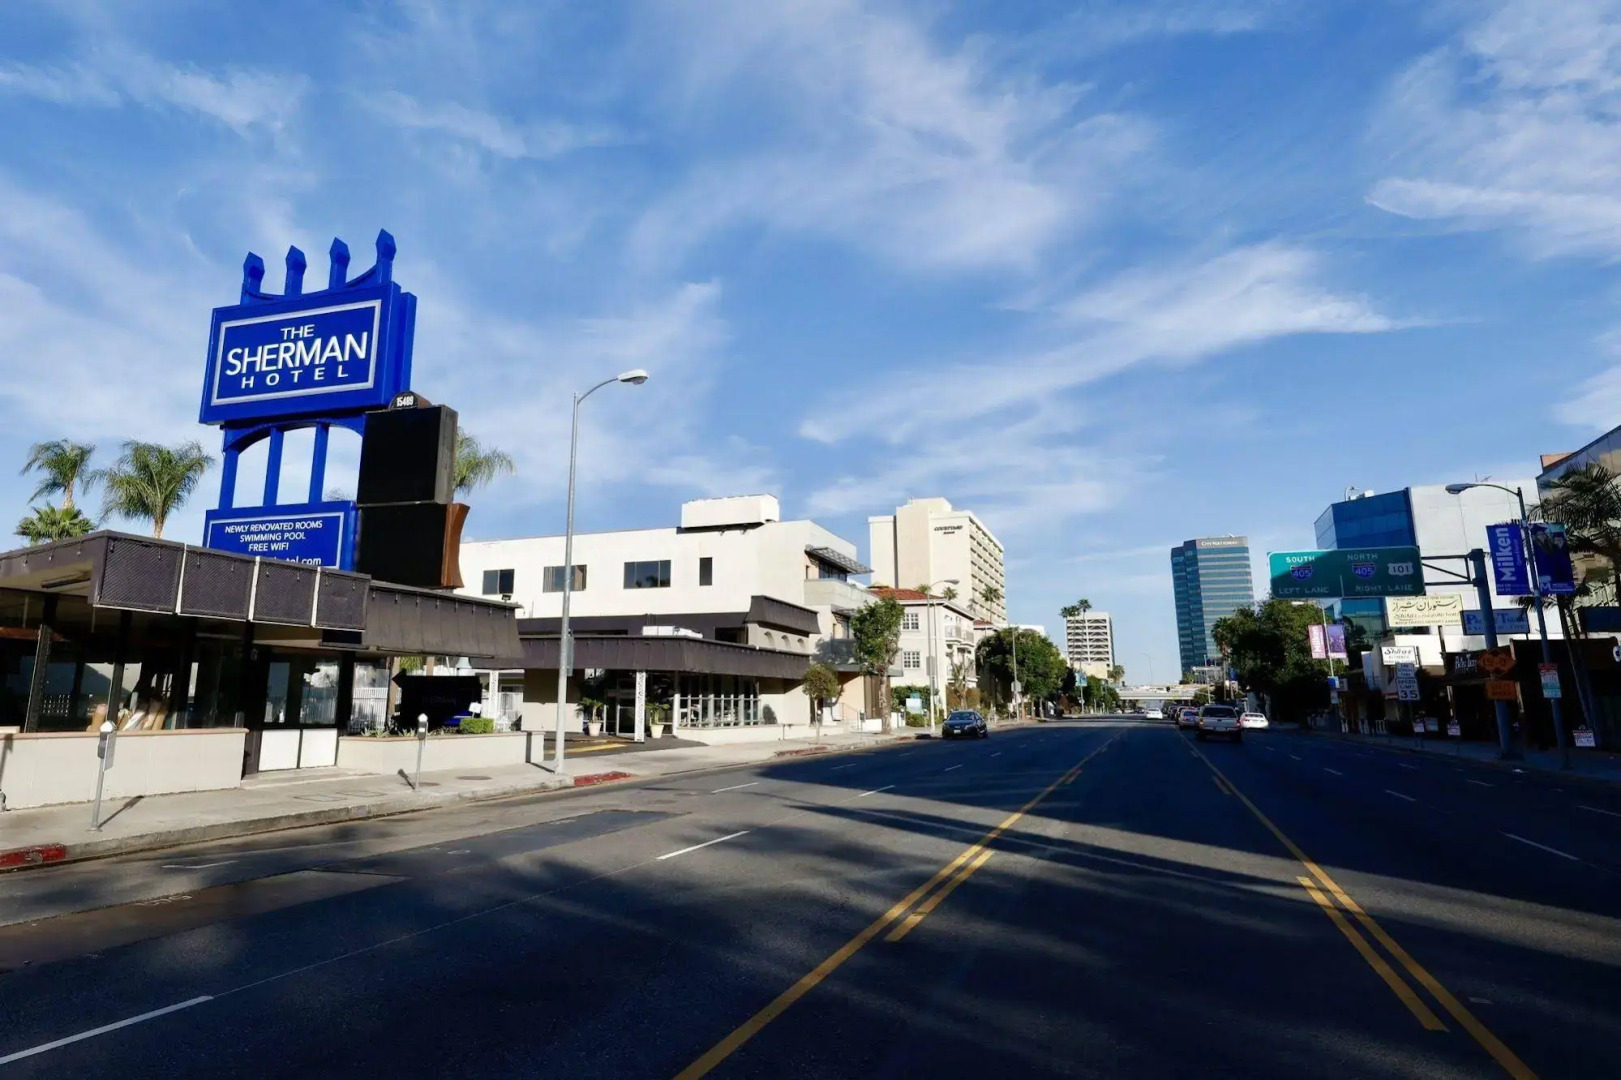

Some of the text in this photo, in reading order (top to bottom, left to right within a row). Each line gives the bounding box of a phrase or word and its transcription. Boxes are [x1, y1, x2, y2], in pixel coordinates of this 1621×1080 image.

[280, 324, 315, 341] THE
[225, 331, 368, 376] SHERMAN
[241, 364, 349, 389] HOTEL
[225, 520, 323, 534] NEWLY RENOVATED ROOMS
[239, 532, 306, 543] SWIMMING POOL
[248, 542, 290, 552] FREE WIFI
[1285, 555, 1316, 563] SOUTH
[1347, 553, 1379, 561] NORTH
[1495, 527, 1517, 581] Milken
[1293, 569, 1311, 578] 405
[1355, 567, 1374, 577] 405
[1392, 564, 1410, 573] 101
[1278, 586, 1329, 595] LEFT LANE
[1387, 583, 1414, 591] LANE
[1400, 689, 1419, 699] 35
